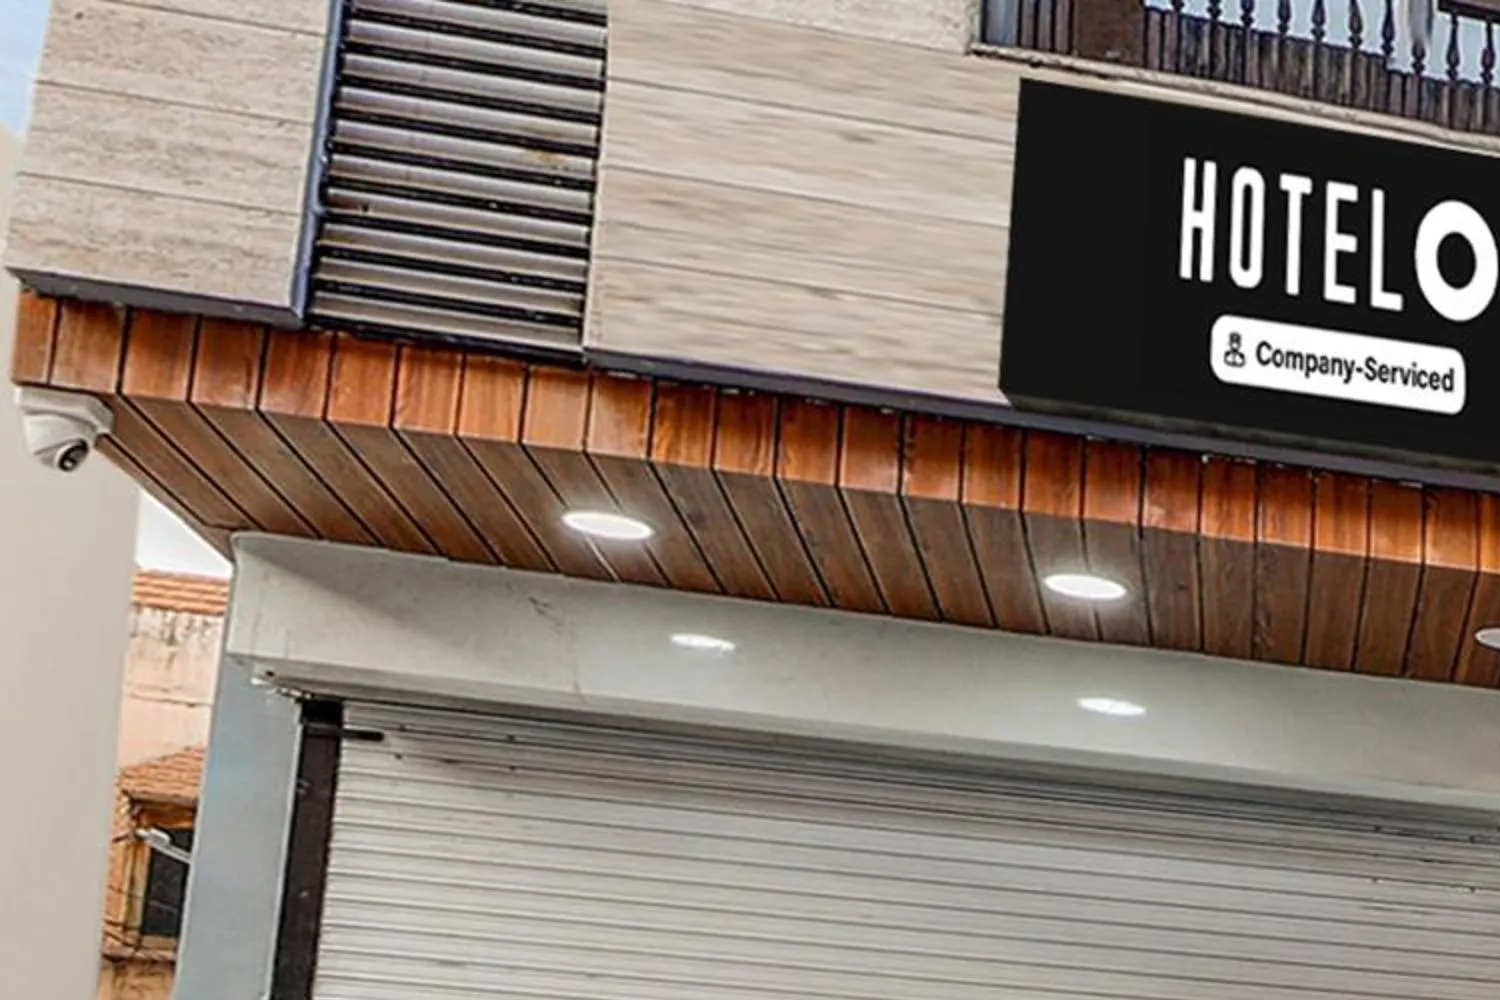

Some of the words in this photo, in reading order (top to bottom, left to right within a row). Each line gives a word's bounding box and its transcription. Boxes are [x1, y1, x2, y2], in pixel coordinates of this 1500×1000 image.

[1179, 157, 1403, 311] HOTEL
[1414, 200, 1499, 322] O
[1255, 340, 1455, 393] Company-Serviced
